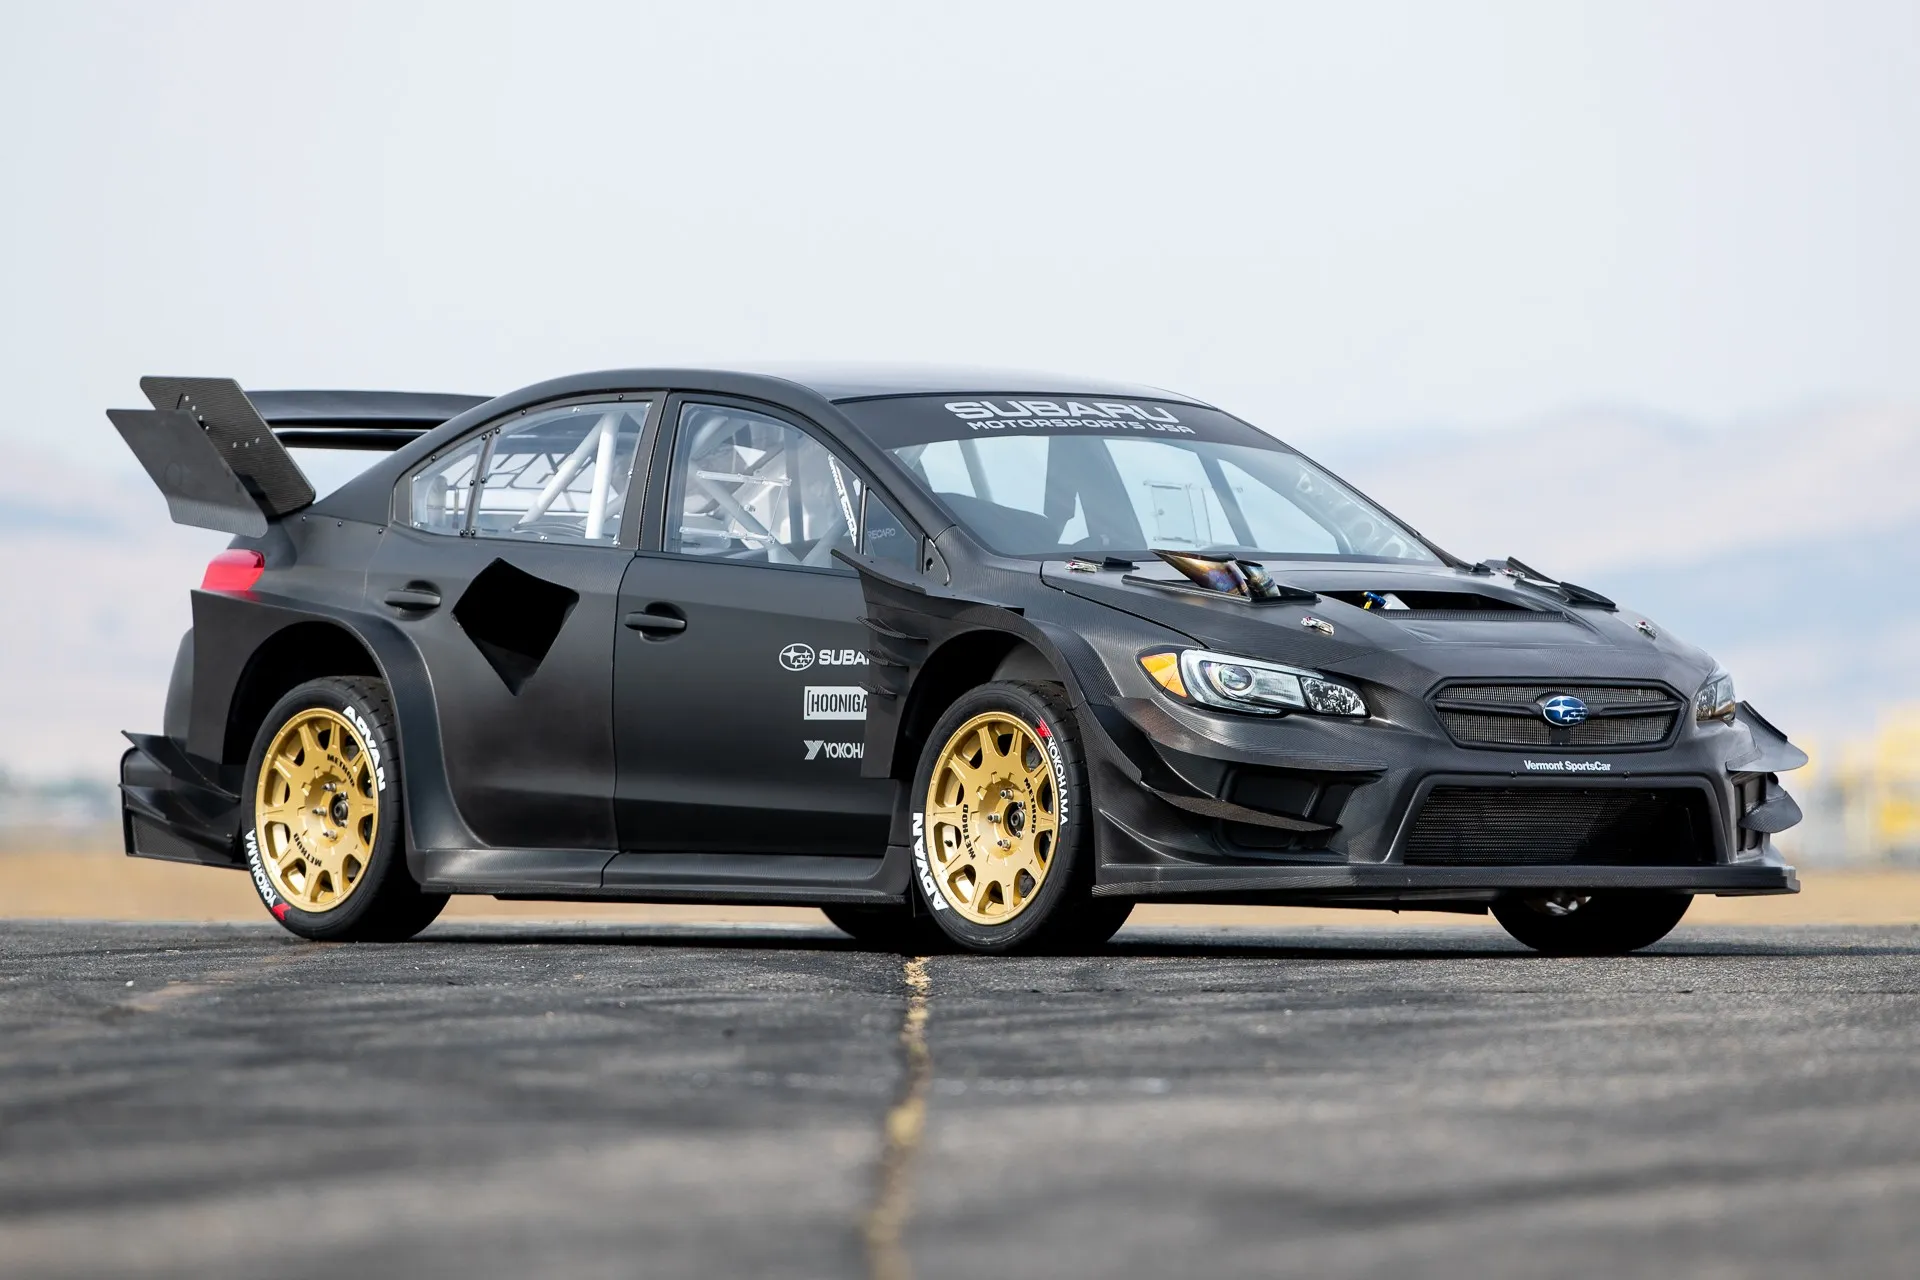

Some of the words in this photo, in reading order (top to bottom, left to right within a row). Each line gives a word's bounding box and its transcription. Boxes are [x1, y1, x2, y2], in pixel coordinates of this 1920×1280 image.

[944, 400, 1180, 423] SUBARU
[967, 418, 1146, 430] MOTORSPORTS
[1148, 422, 1196, 434] USA
[818, 649, 870, 666] SUBA
[343, 706, 386, 792] ADVAN
[1523, 760, 1564, 770] Vermont
[1564, 761, 1611, 772] SportsCar
[1024, 777, 1036, 834] METHOD
[1047, 736, 1069, 826] YOKOHAMA
[962, 804, 976, 860] METHOD
[245, 828, 277, 907] YOKOHAMA
[912, 812, 949, 911] ADVAN
